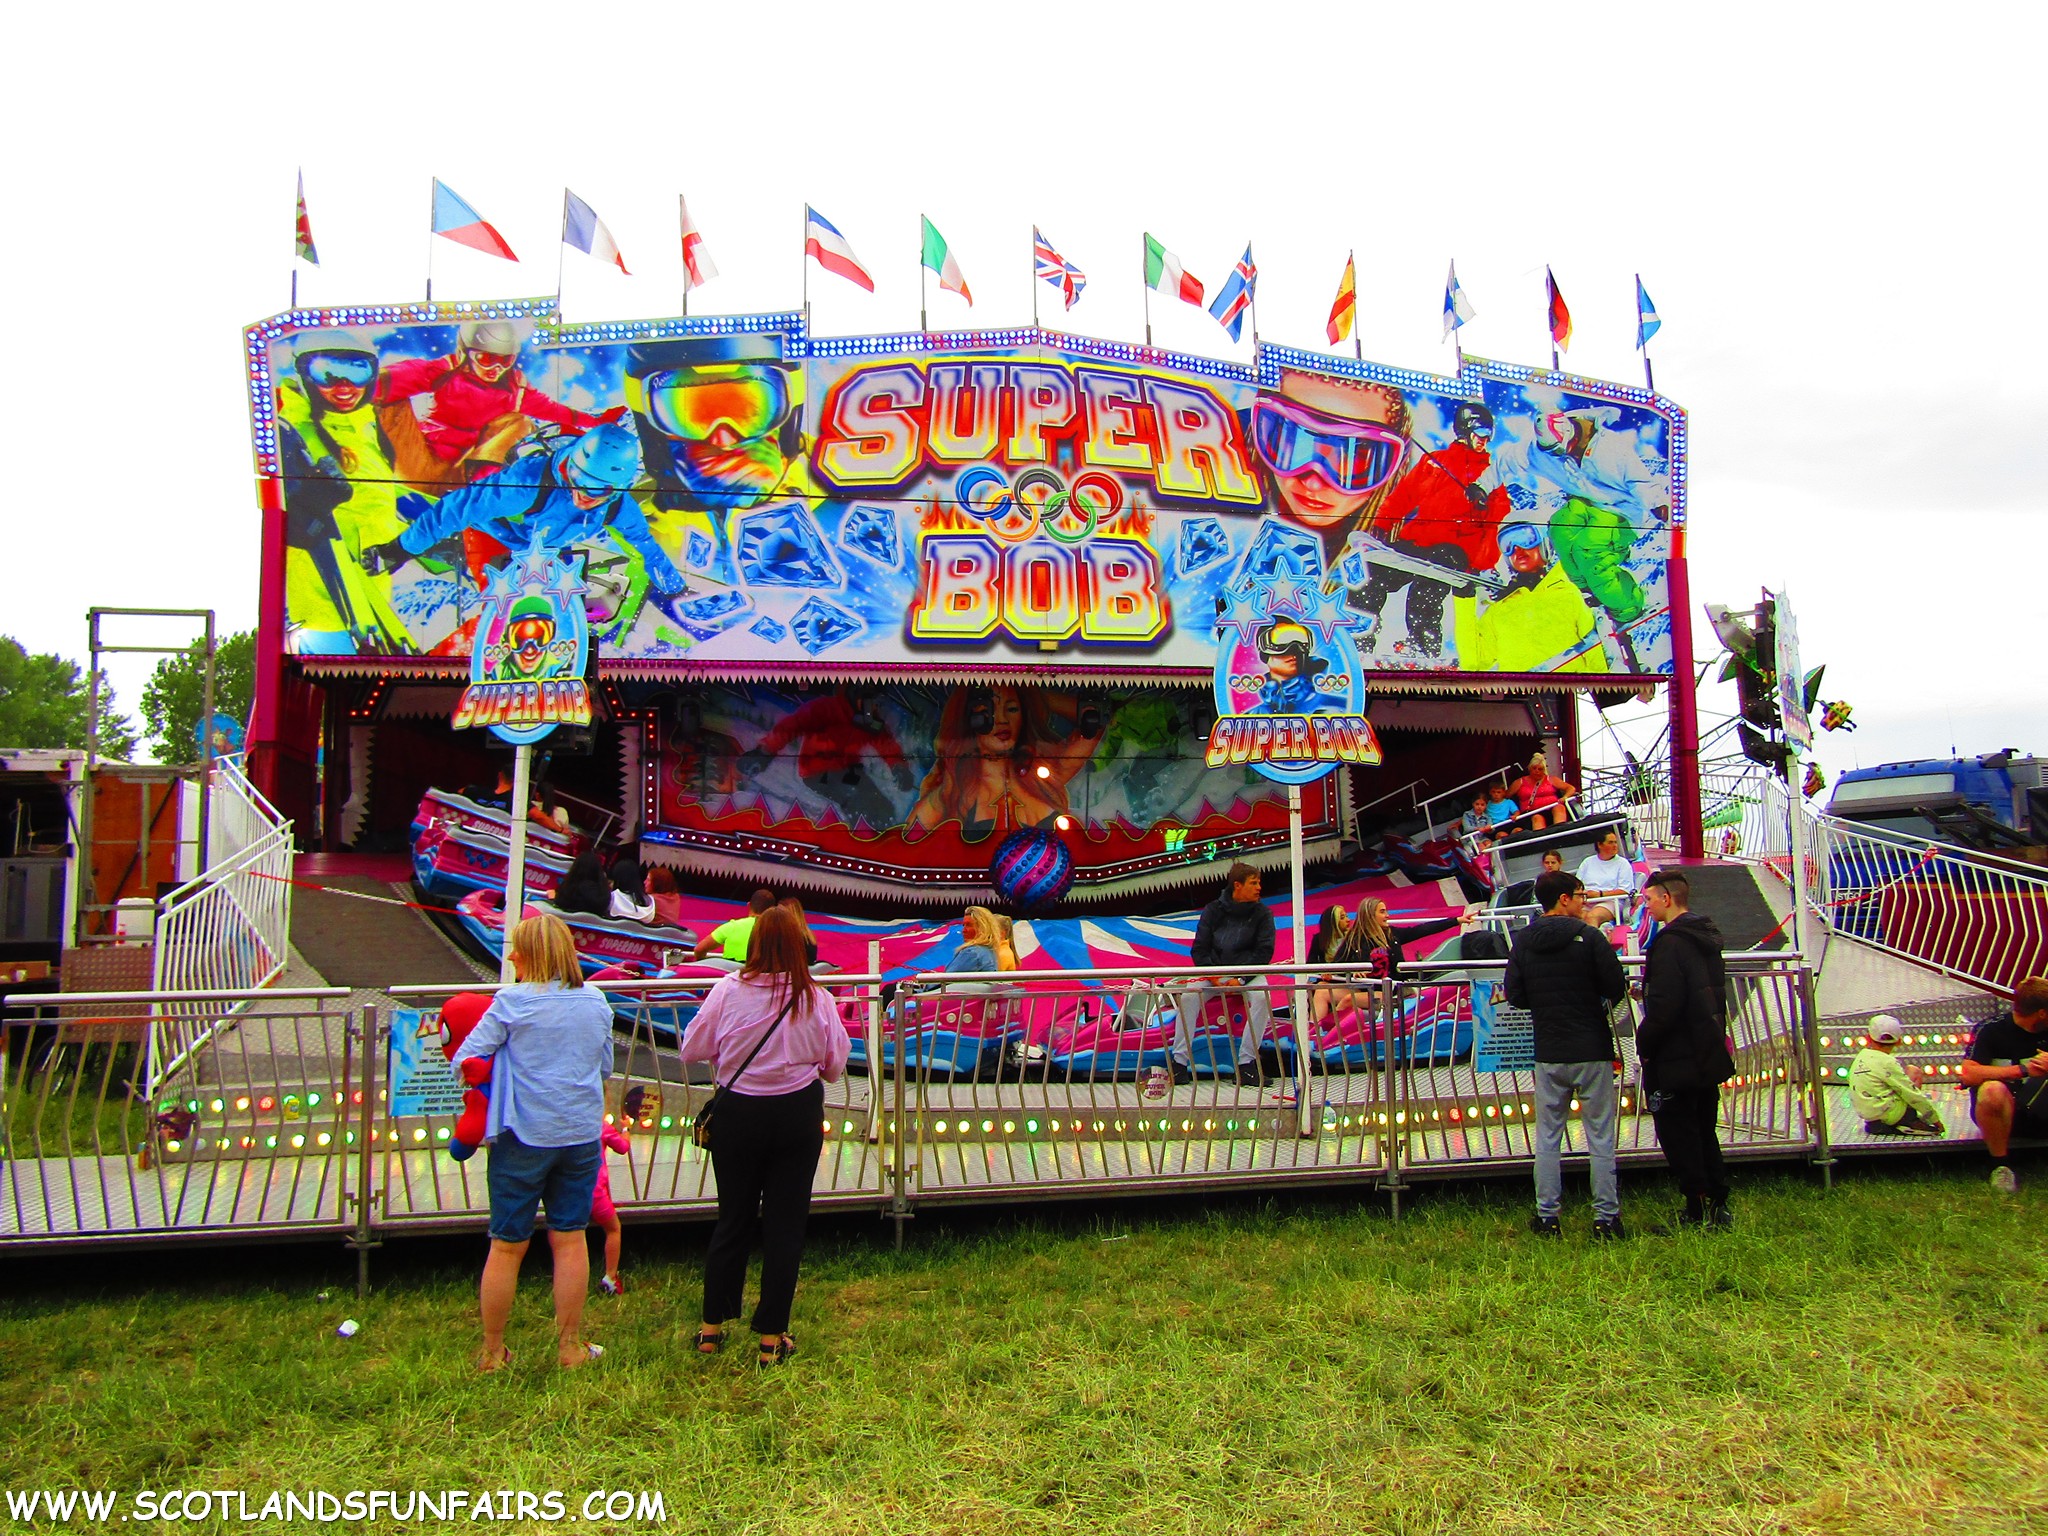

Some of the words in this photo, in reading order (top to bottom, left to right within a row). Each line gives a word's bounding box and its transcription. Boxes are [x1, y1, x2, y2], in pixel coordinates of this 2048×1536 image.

[818, 360, 1262, 502] SUPER
[914, 535, 1164, 638] BOB
[452, 682, 540, 730] SUPER
[541, 679, 591, 726] BOB
[1206, 717, 1313, 768] SUPER
[1312, 716, 1382, 766] BOB
[600, 936, 645, 956] SUPERBOB
